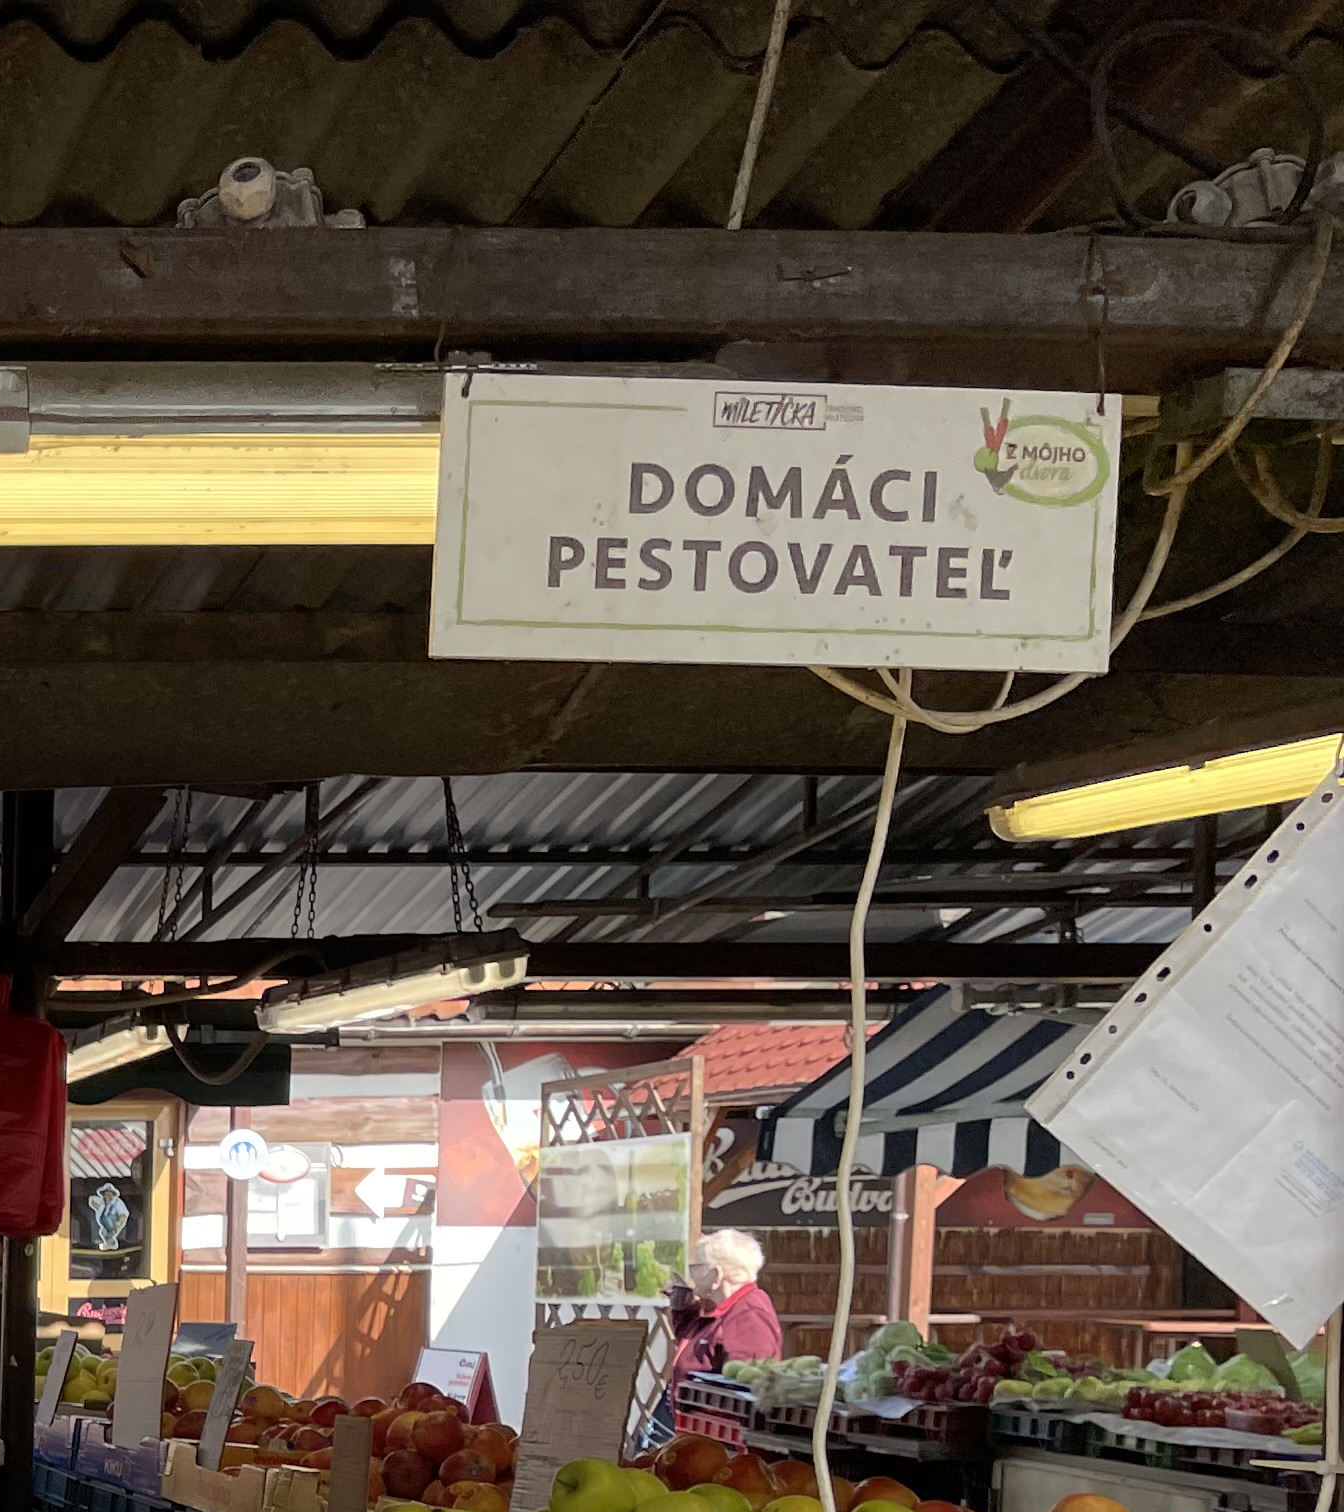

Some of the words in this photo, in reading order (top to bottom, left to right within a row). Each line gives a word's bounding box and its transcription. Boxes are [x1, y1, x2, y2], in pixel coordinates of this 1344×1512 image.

[1021, 442, 1087, 465] MÔJHO
[628, 453, 938, 523] DOMÁCI
[547, 535, 1014, 601] PESTOVATEĽ
